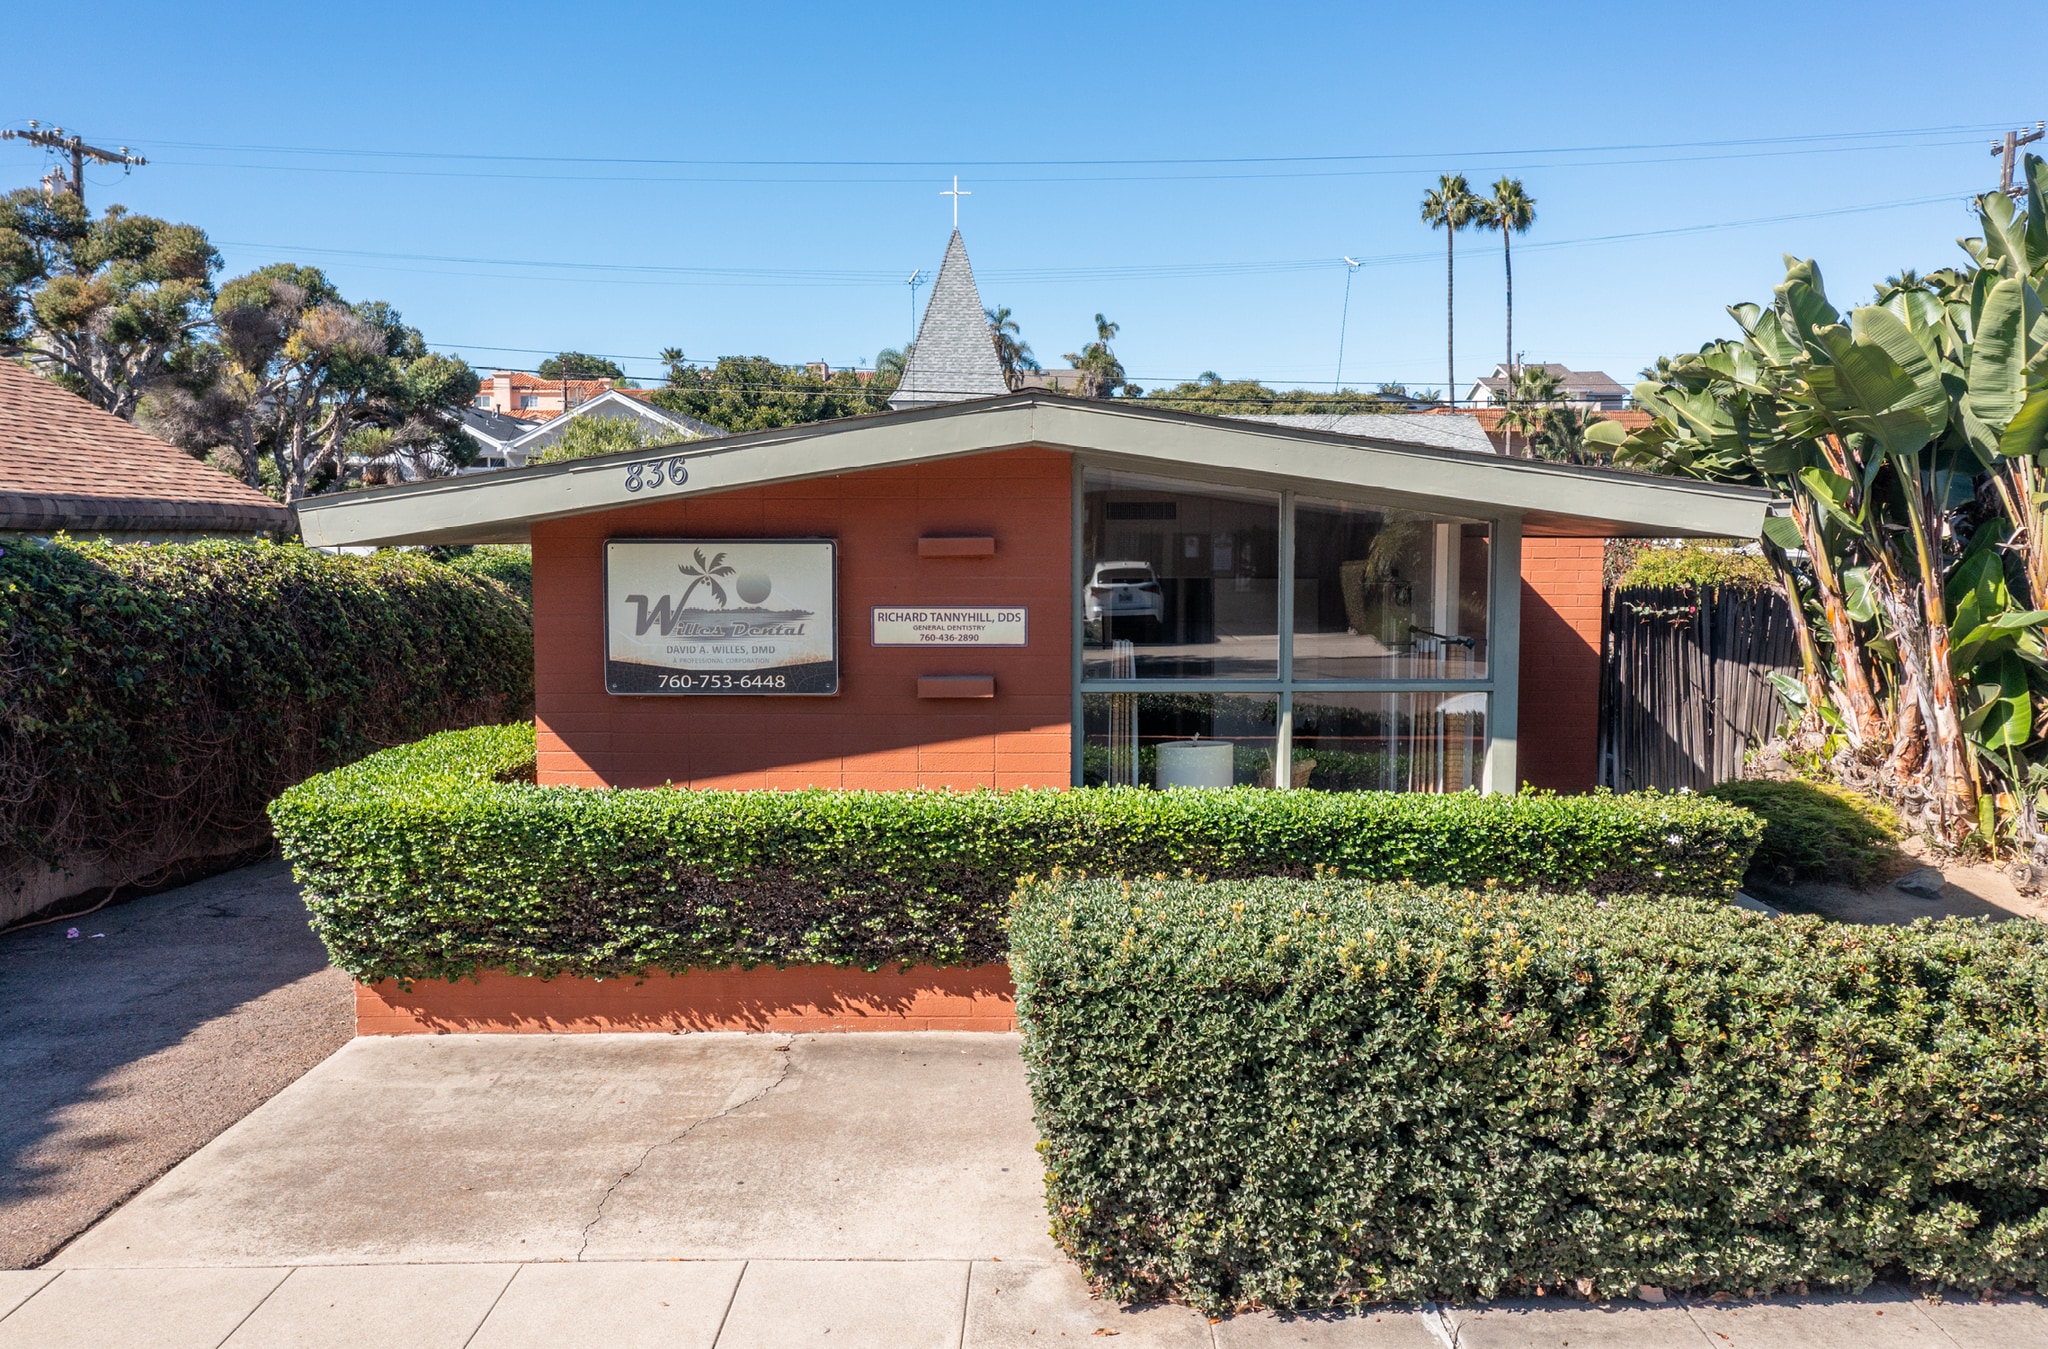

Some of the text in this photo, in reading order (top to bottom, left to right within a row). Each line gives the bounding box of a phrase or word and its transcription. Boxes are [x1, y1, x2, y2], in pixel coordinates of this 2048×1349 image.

[625, 456, 688, 492] 836
[625, 594, 806, 638] Willes Dental
[877, 612, 1022, 624] RICHARD TANNYHILL, DDS
[919, 633, 979, 642] 760-436-2890
[666, 645, 776, 655] DAVID A. WILLES, DMD
[658, 675, 786, 688] 760-753-6448
